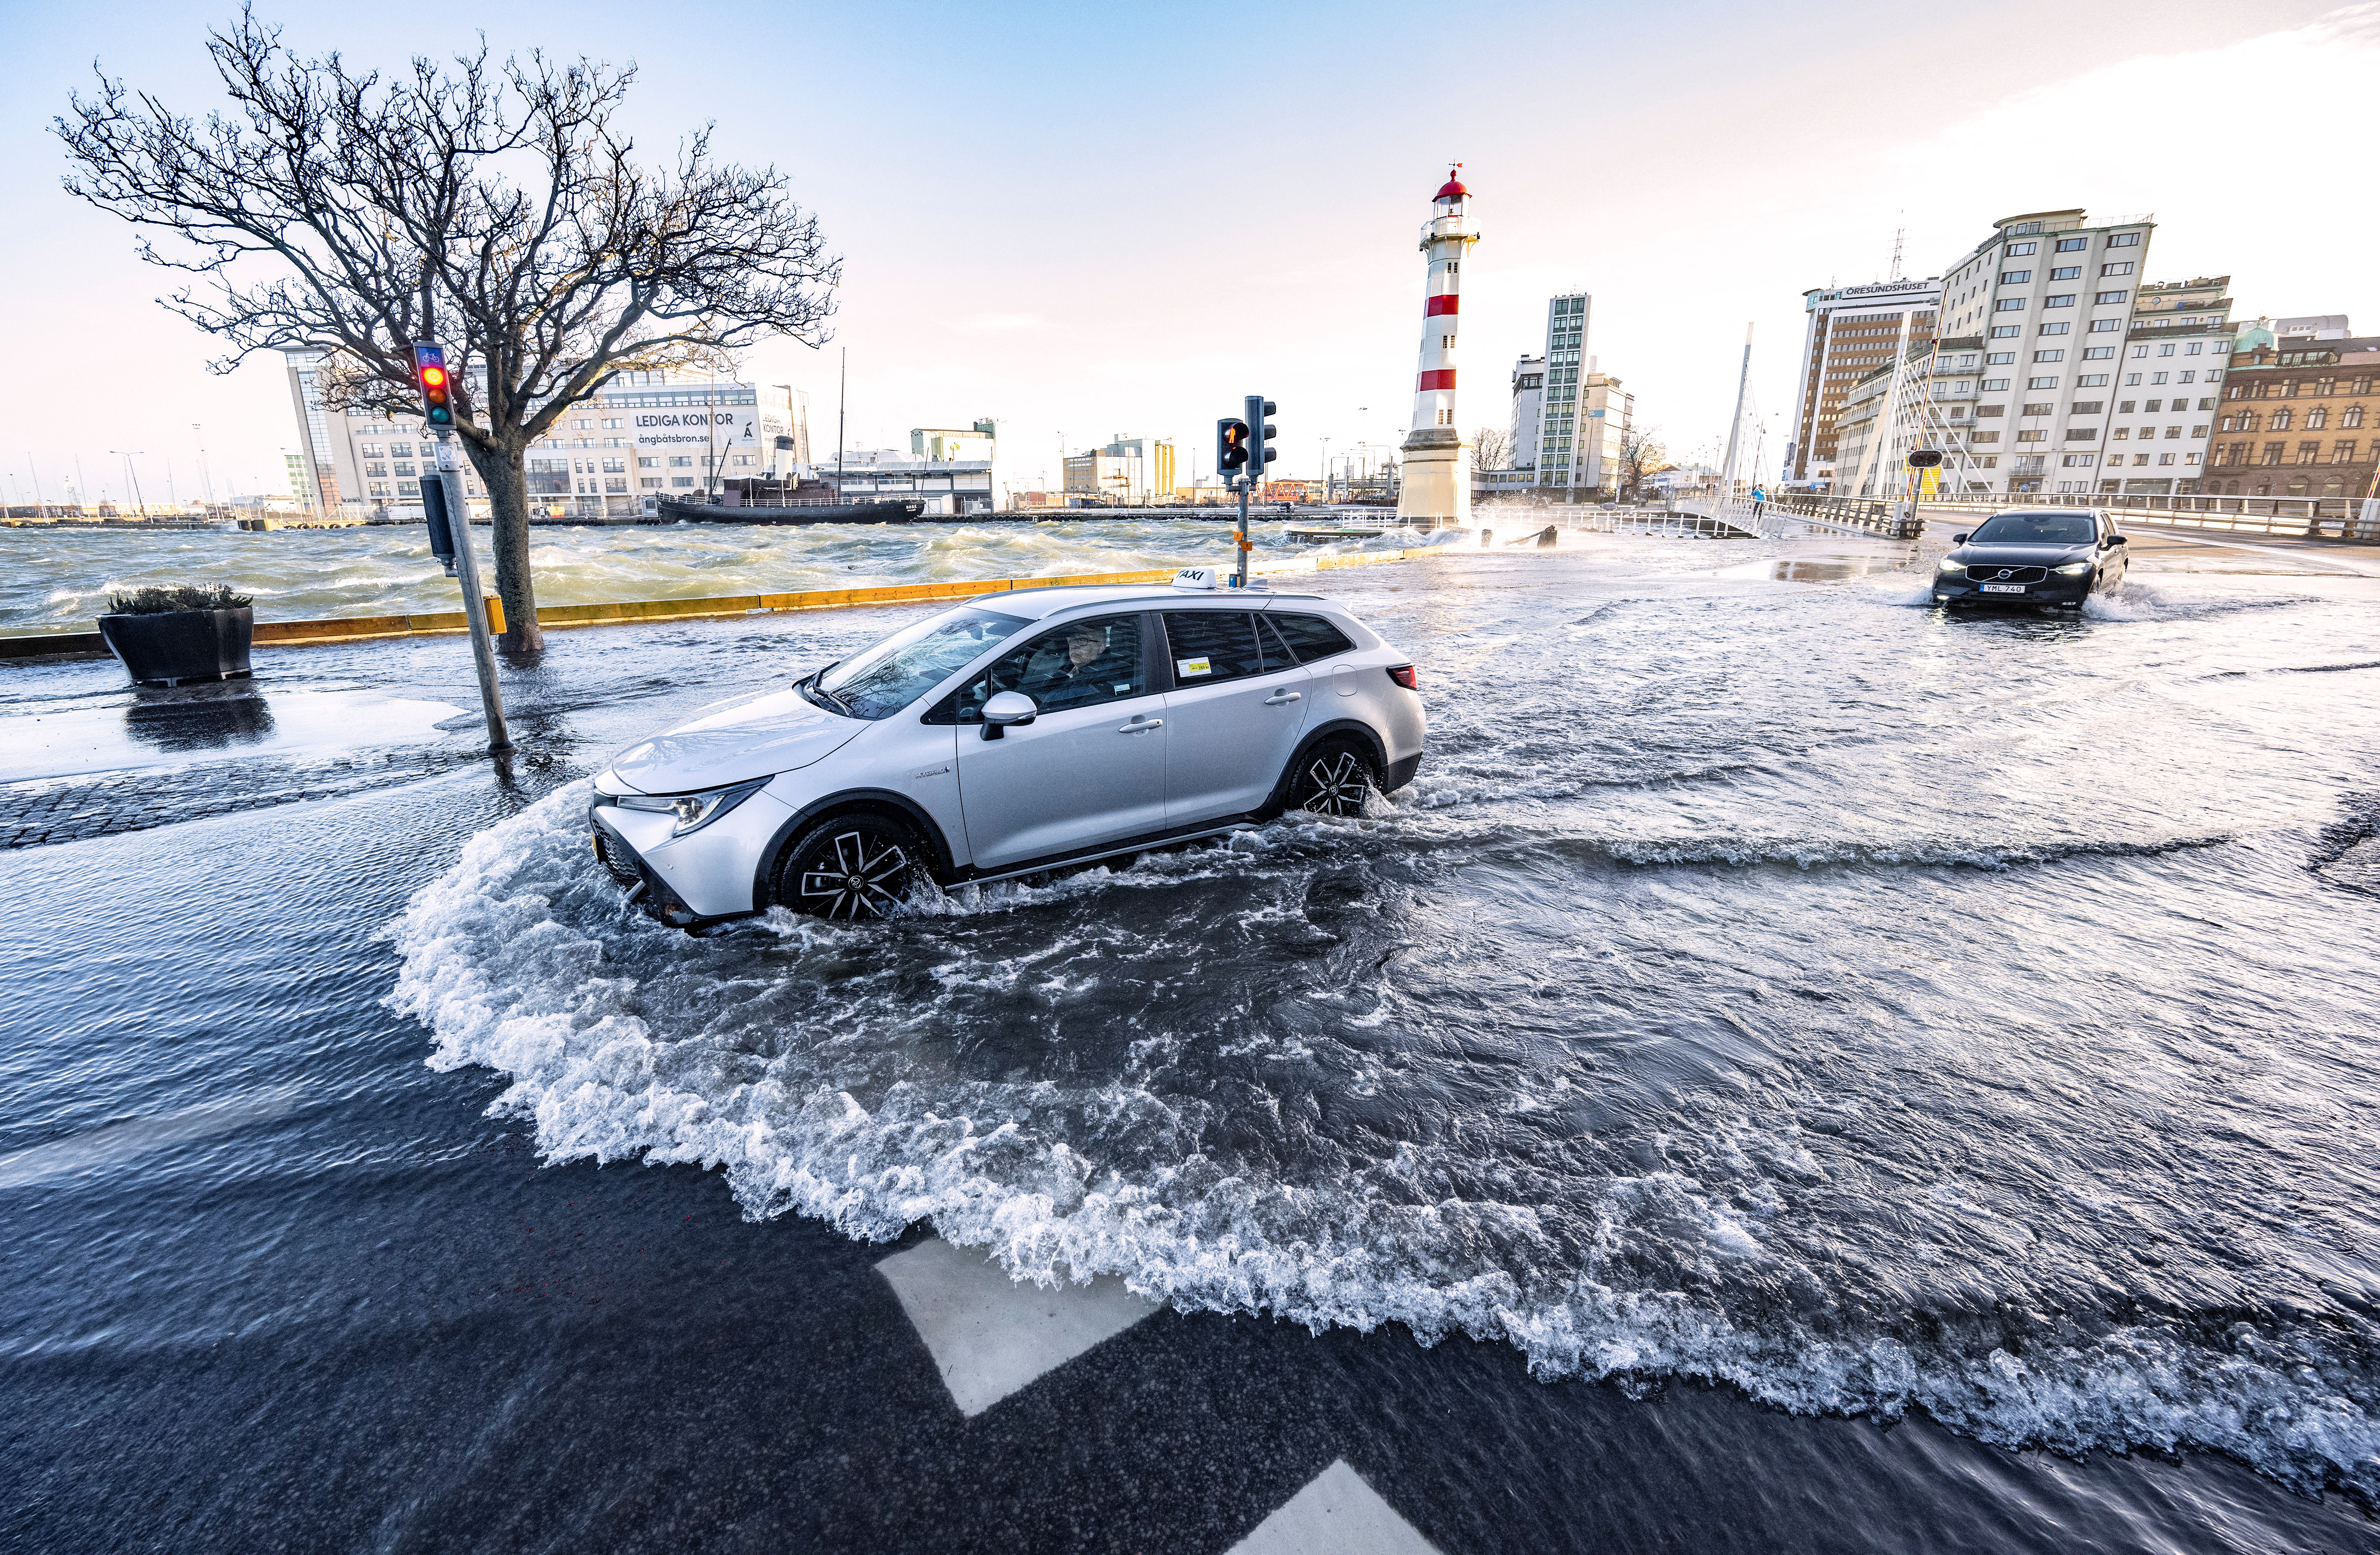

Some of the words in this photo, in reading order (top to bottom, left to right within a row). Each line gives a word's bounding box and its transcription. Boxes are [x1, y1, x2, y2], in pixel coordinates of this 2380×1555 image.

[1846, 282, 1929, 295] ÖRESUNDSHUSET
[636, 414, 680, 427] LEDIGA
[683, 413, 733, 426] KONOR
[762, 414, 781, 424] LEDIGA
[763, 424, 784, 434] KONTOR
[639, 434, 709, 445] ångbåtsbron.se
[1176, 569, 1204, 581] TAXI
[916, 768, 944, 778] HYBRID
